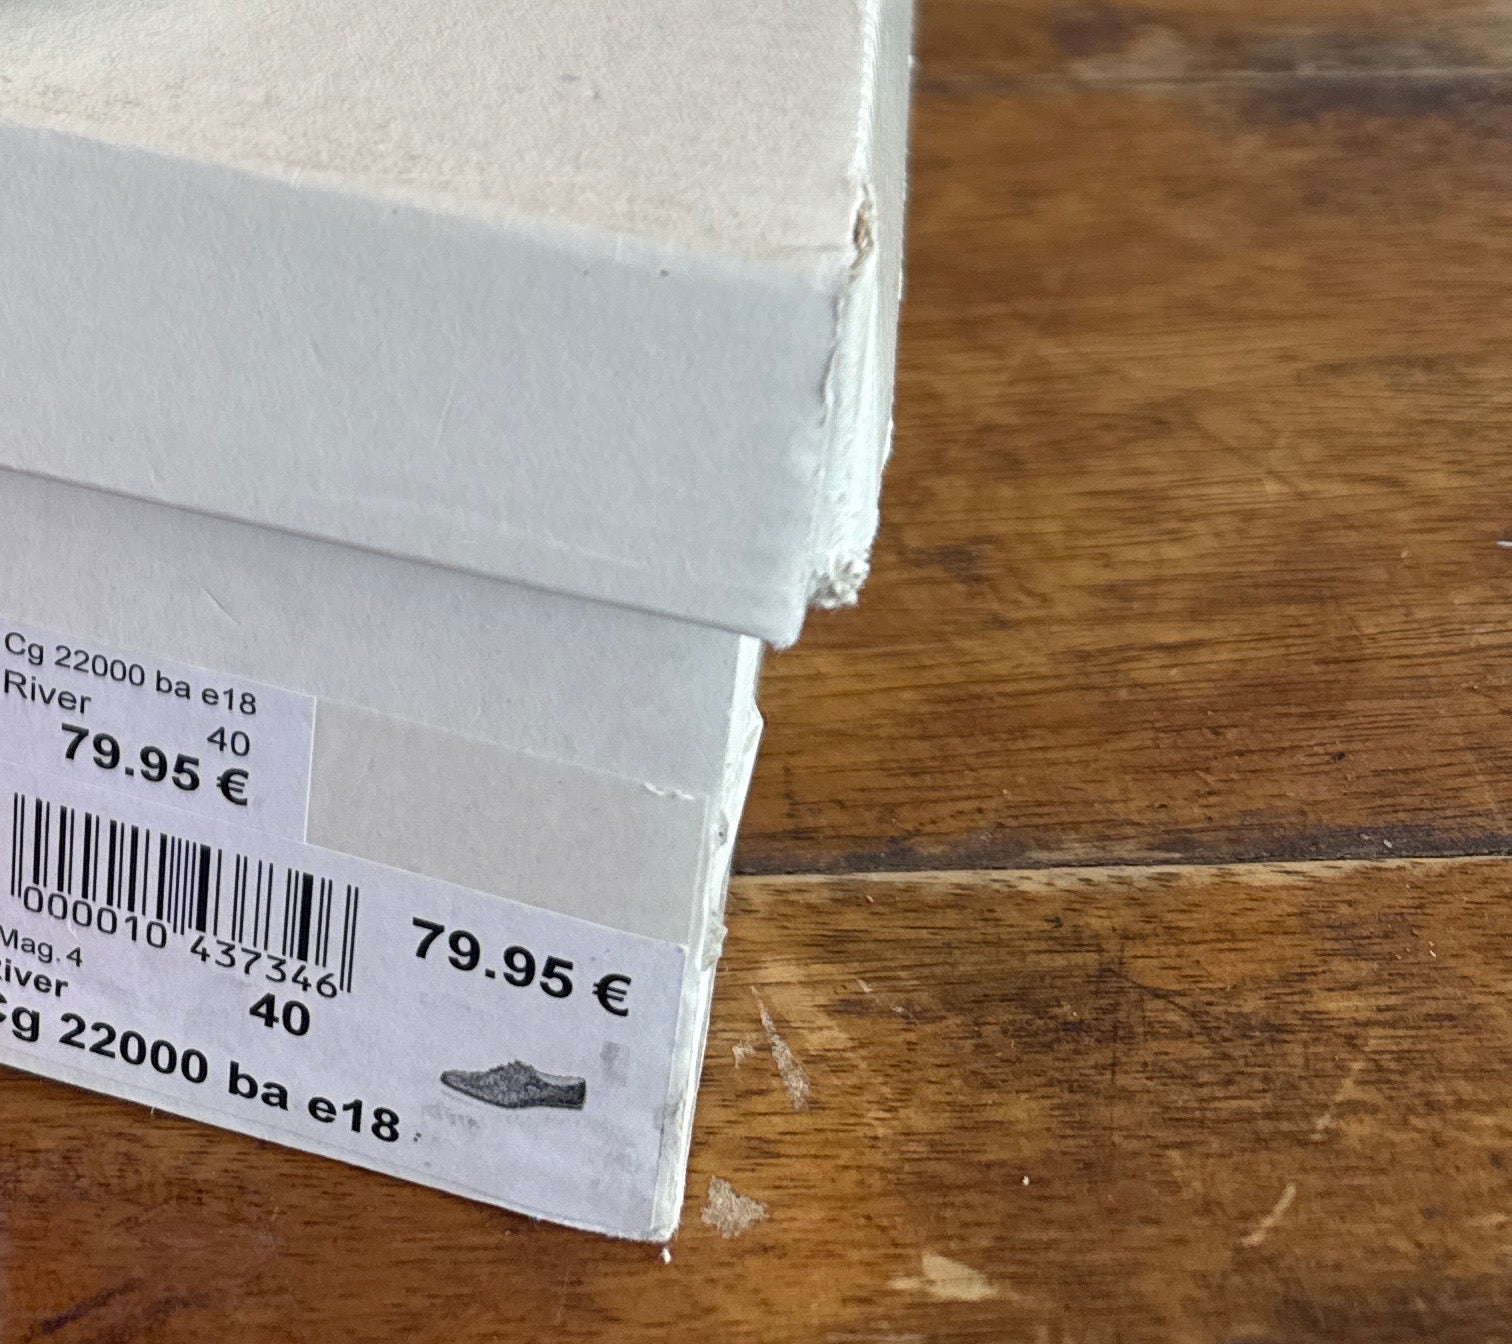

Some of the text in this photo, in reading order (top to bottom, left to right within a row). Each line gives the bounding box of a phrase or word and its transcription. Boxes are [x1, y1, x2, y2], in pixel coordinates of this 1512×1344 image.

[3, 630, 257, 716] Cg 22000 ba e18
[3, 667, 251, 757] River 40
[60, 722, 250, 807] 79.95 €
[23, 885, 168, 950] 000010
[189, 934, 338, 999] 437346
[411, 916, 632, 1018] 79.95 €
[248, 992, 311, 1037] 40
[58, 1012, 208, 1085] 22000
[228, 1060, 289, 1112] ba
[306, 1095, 400, 1143] e18
